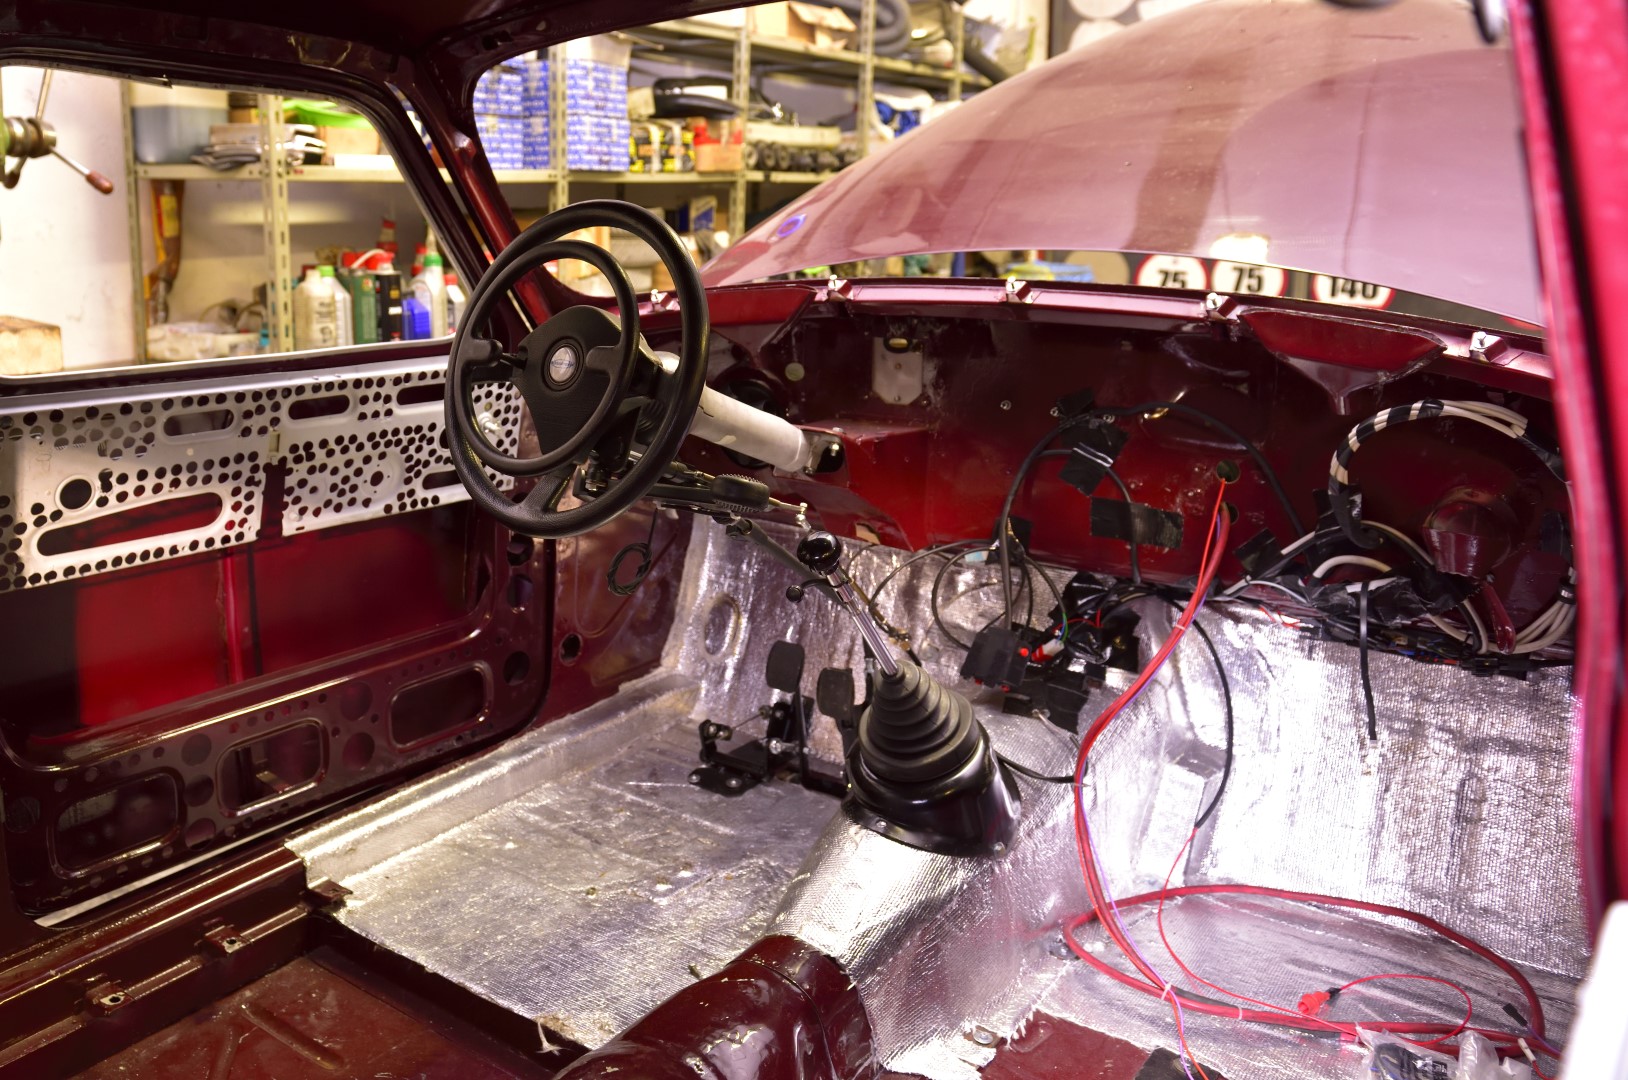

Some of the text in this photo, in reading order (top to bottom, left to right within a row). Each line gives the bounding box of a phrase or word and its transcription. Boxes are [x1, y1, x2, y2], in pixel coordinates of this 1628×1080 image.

[1158, 270, 1188, 288] 75
[1231, 266, 1264, 293] 75
[1328, 277, 1378, 299] 140
